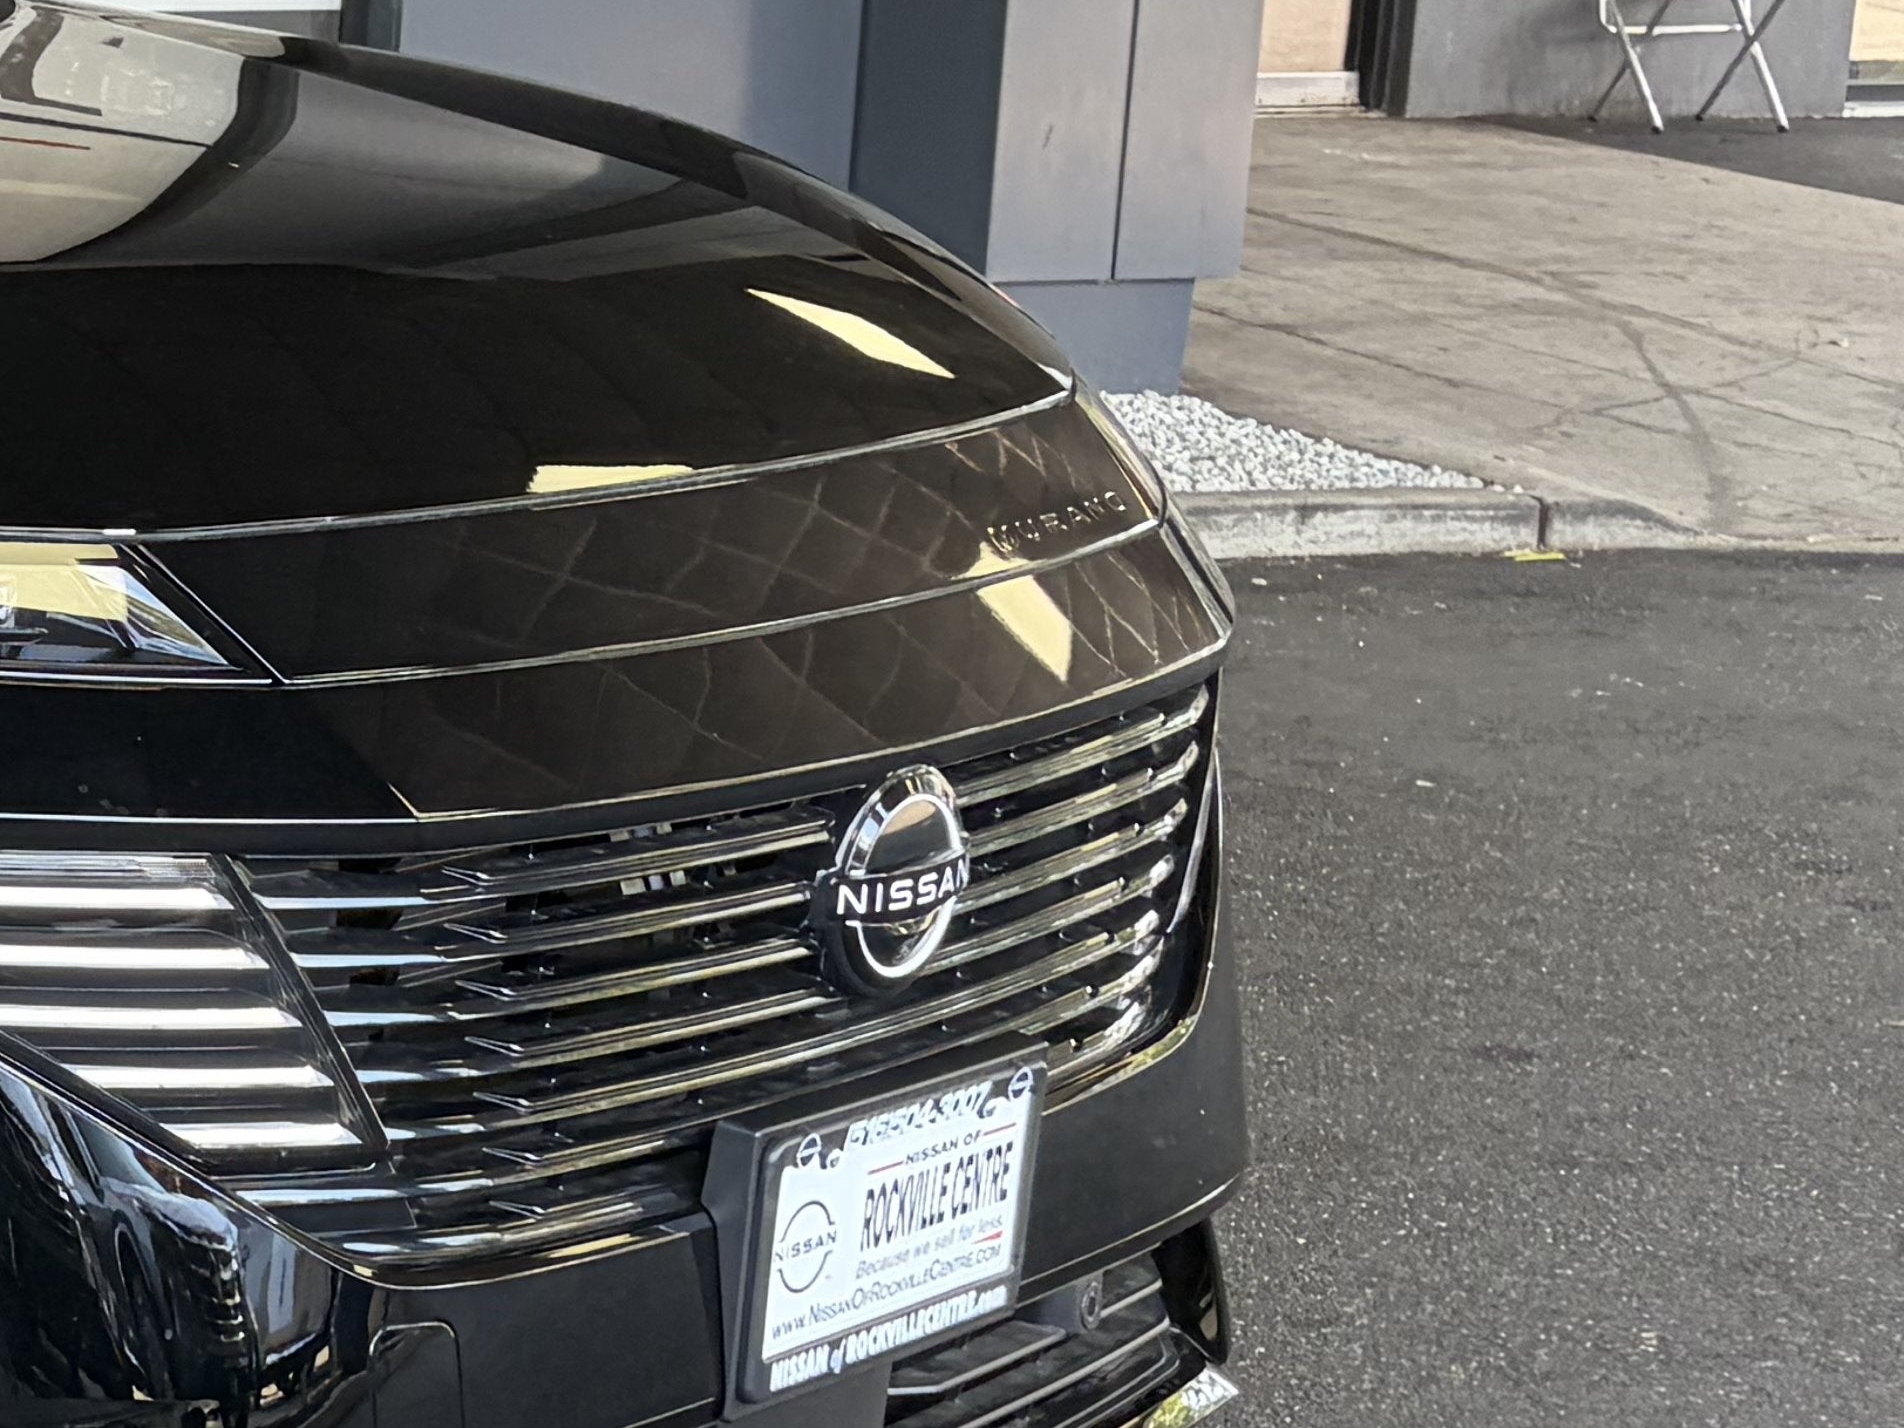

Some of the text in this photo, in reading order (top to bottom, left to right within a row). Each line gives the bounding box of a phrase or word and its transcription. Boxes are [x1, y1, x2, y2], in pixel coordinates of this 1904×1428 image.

[836, 858, 970, 915] NISSAN
[905, 1138, 958, 1166] NISSAN
[860, 1141, 1013, 1252] ROCKVILLE CENTRE
[774, 1230, 837, 1263] NISSAN
